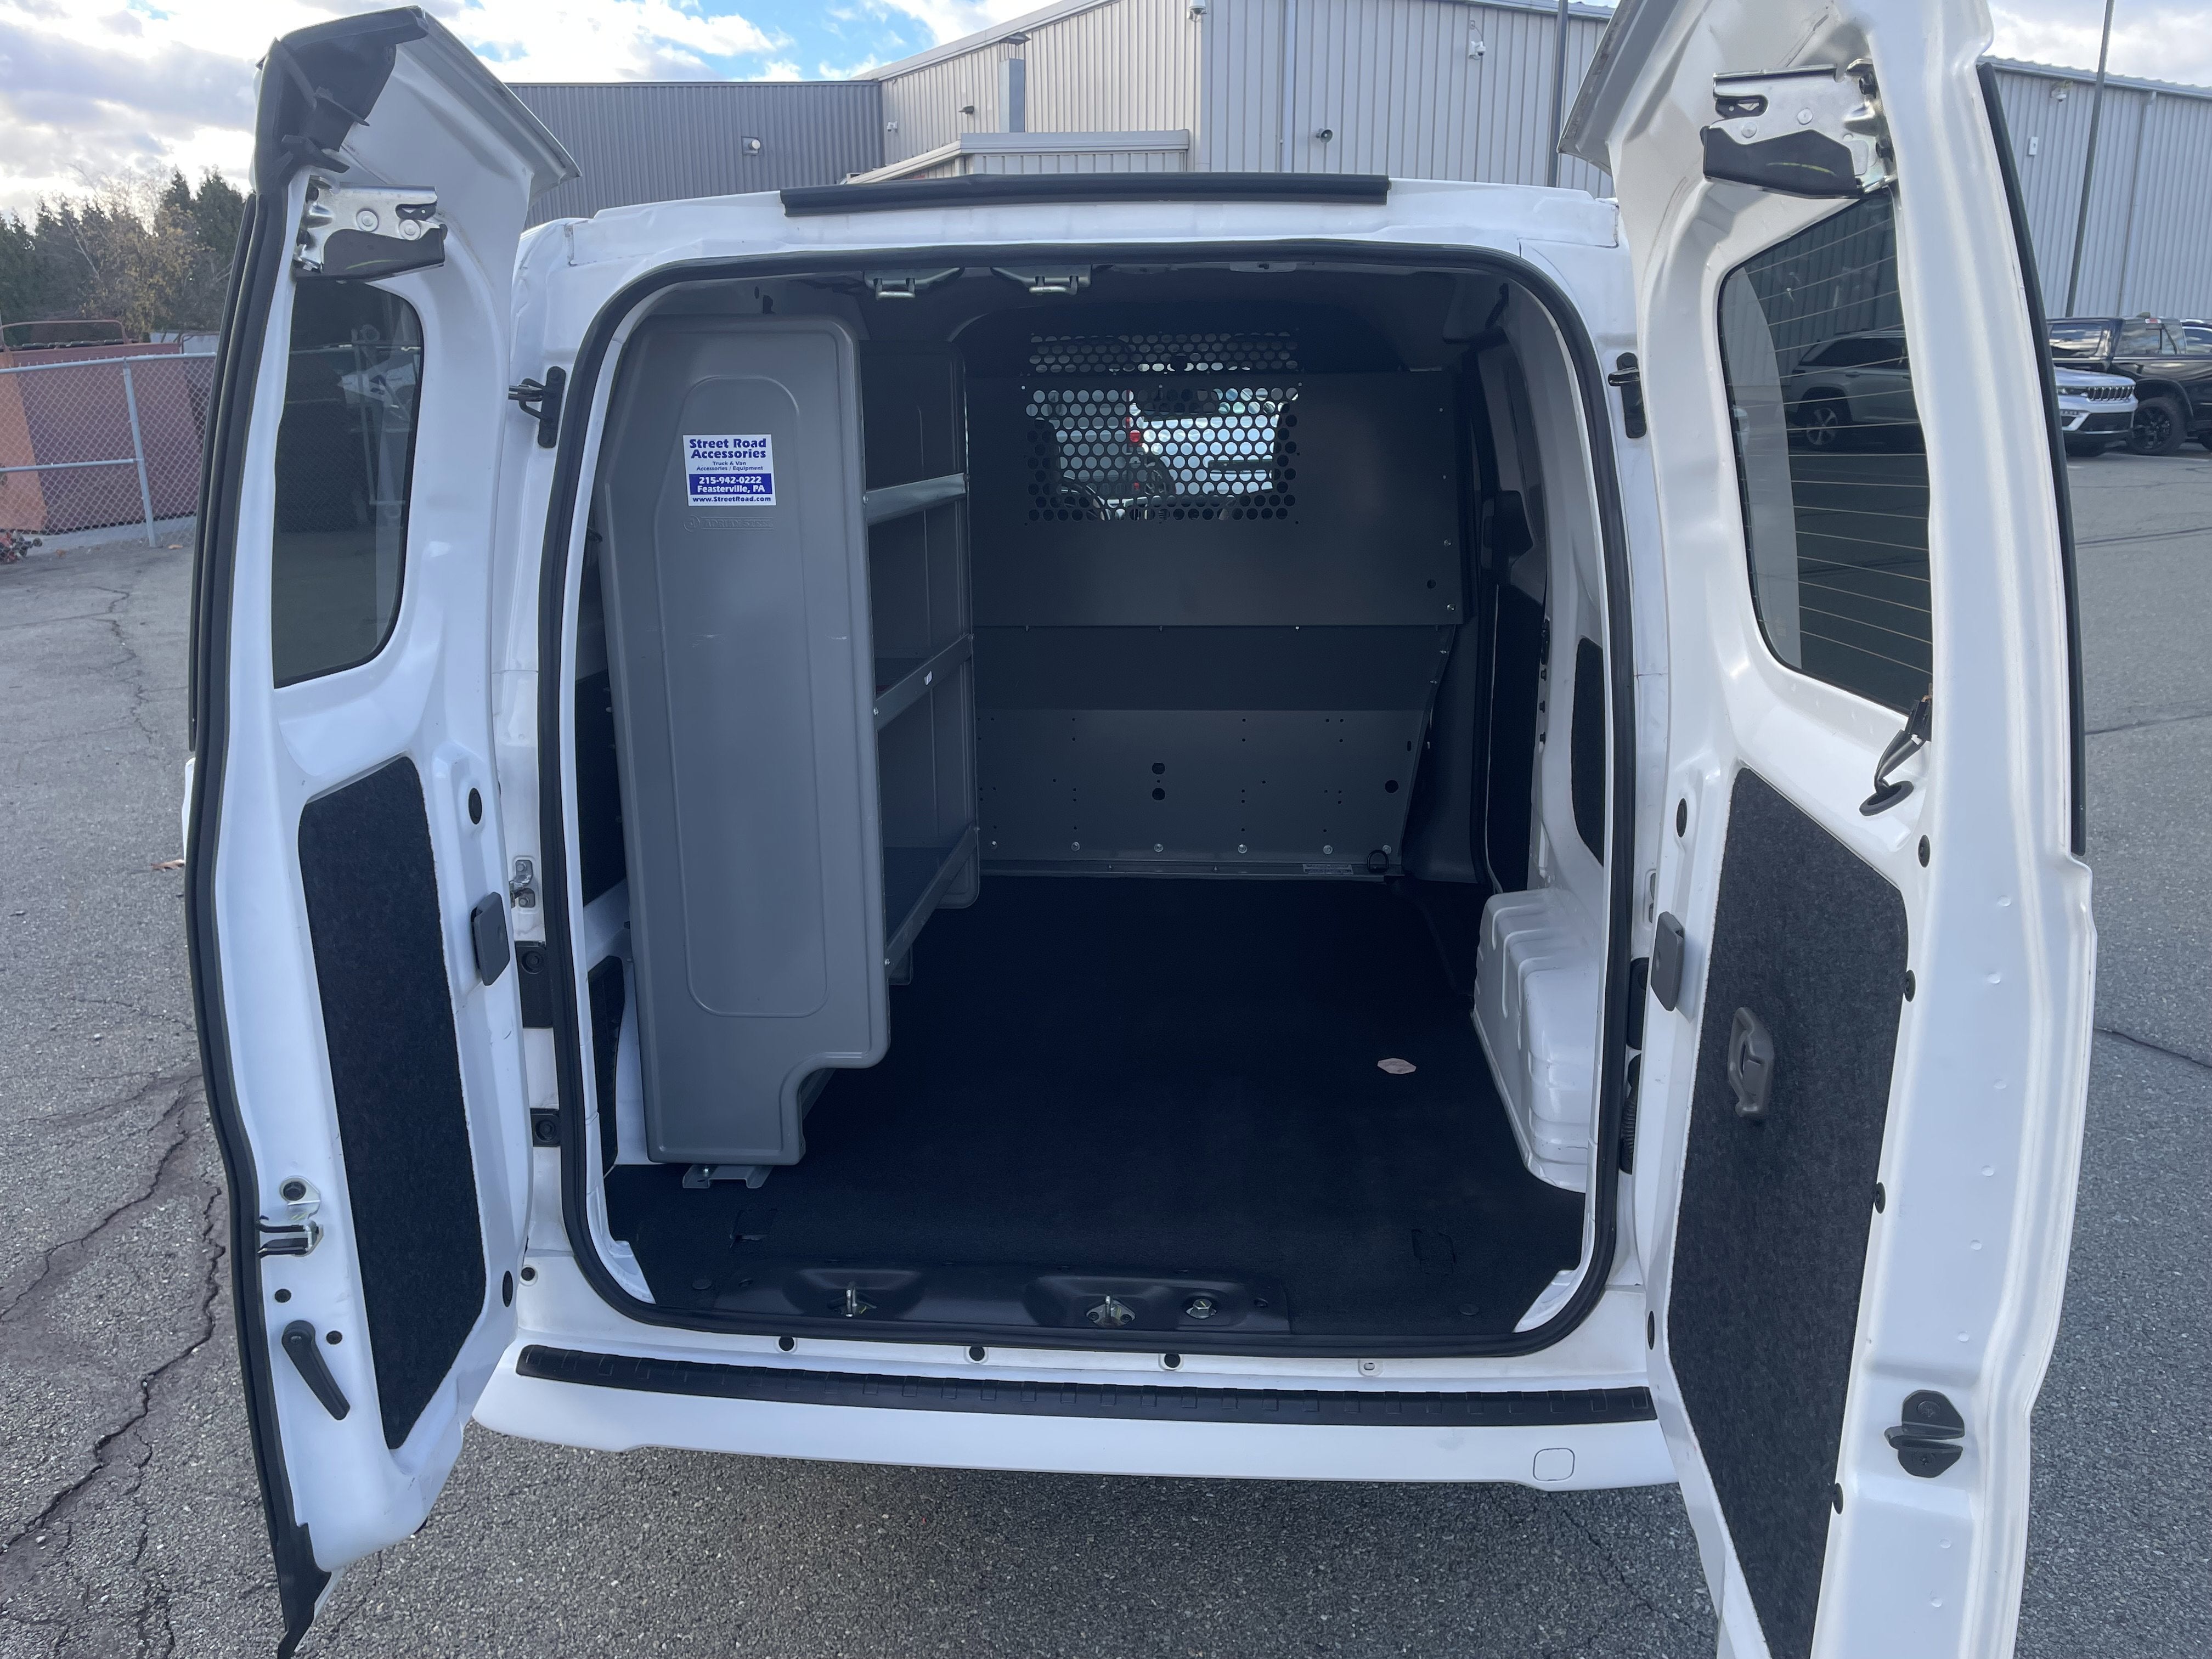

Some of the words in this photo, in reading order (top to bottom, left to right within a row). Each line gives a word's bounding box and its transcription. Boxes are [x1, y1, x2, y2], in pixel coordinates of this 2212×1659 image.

[689, 439, 729, 448] Street
[733, 438, 766, 448] Road
[690, 449, 766, 459] Accessories
[698, 476, 762, 484] 215-942-0222
[697, 485, 751, 494] Feasterville,
